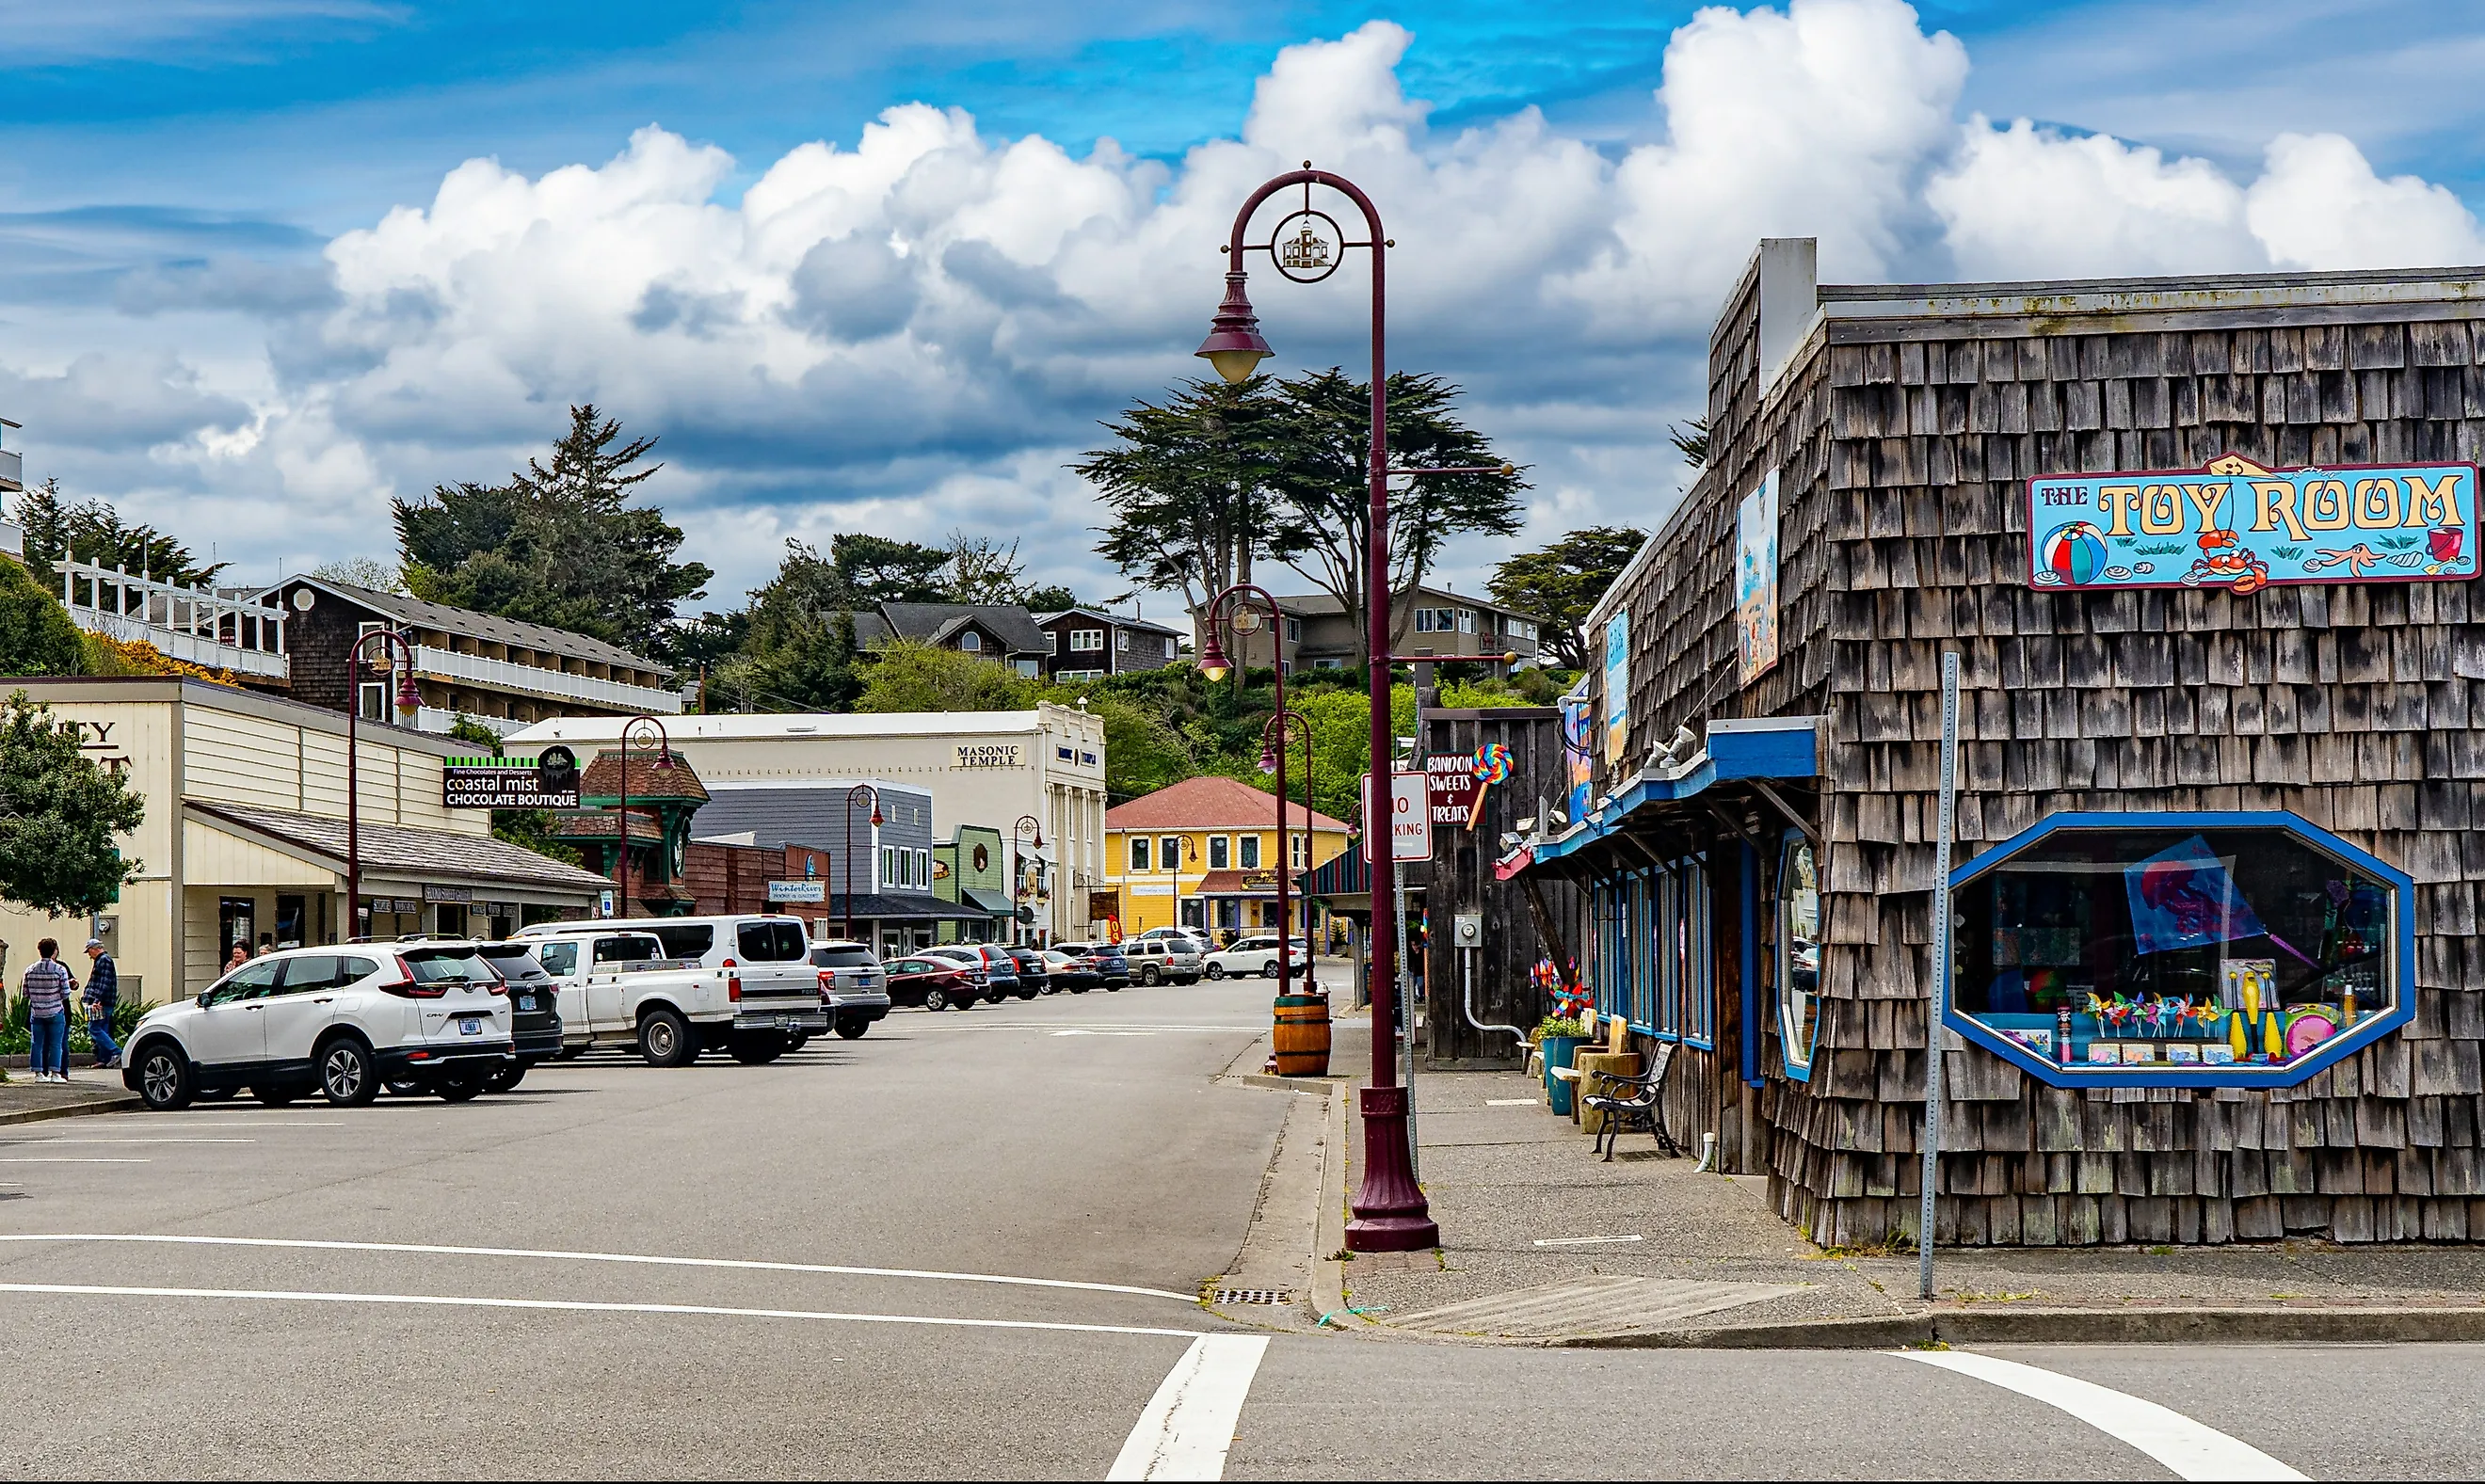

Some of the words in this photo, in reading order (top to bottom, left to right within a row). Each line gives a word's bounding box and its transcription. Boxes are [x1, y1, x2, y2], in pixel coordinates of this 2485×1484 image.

[2041, 486, 2088, 506] THE
[2098, 483, 2234, 535] TOY
[2247, 475, 2465, 541] ROOM
[957, 745, 1018, 757] MASONIC
[960, 756, 1016, 766] TEMPLE
[1427, 756, 1473, 773] BANDON
[447, 775, 500, 791] coastal
[505, 776, 539, 791] mist
[1430, 774, 1471, 791] SWEETS
[447, 793, 516, 806] CHOCOLATE
[518, 794, 577, 806] BOUTIQUE
[1392, 797, 1409, 814] O
[1432, 806, 1469, 822] TREATS
[1393, 822, 1423, 836] KING
